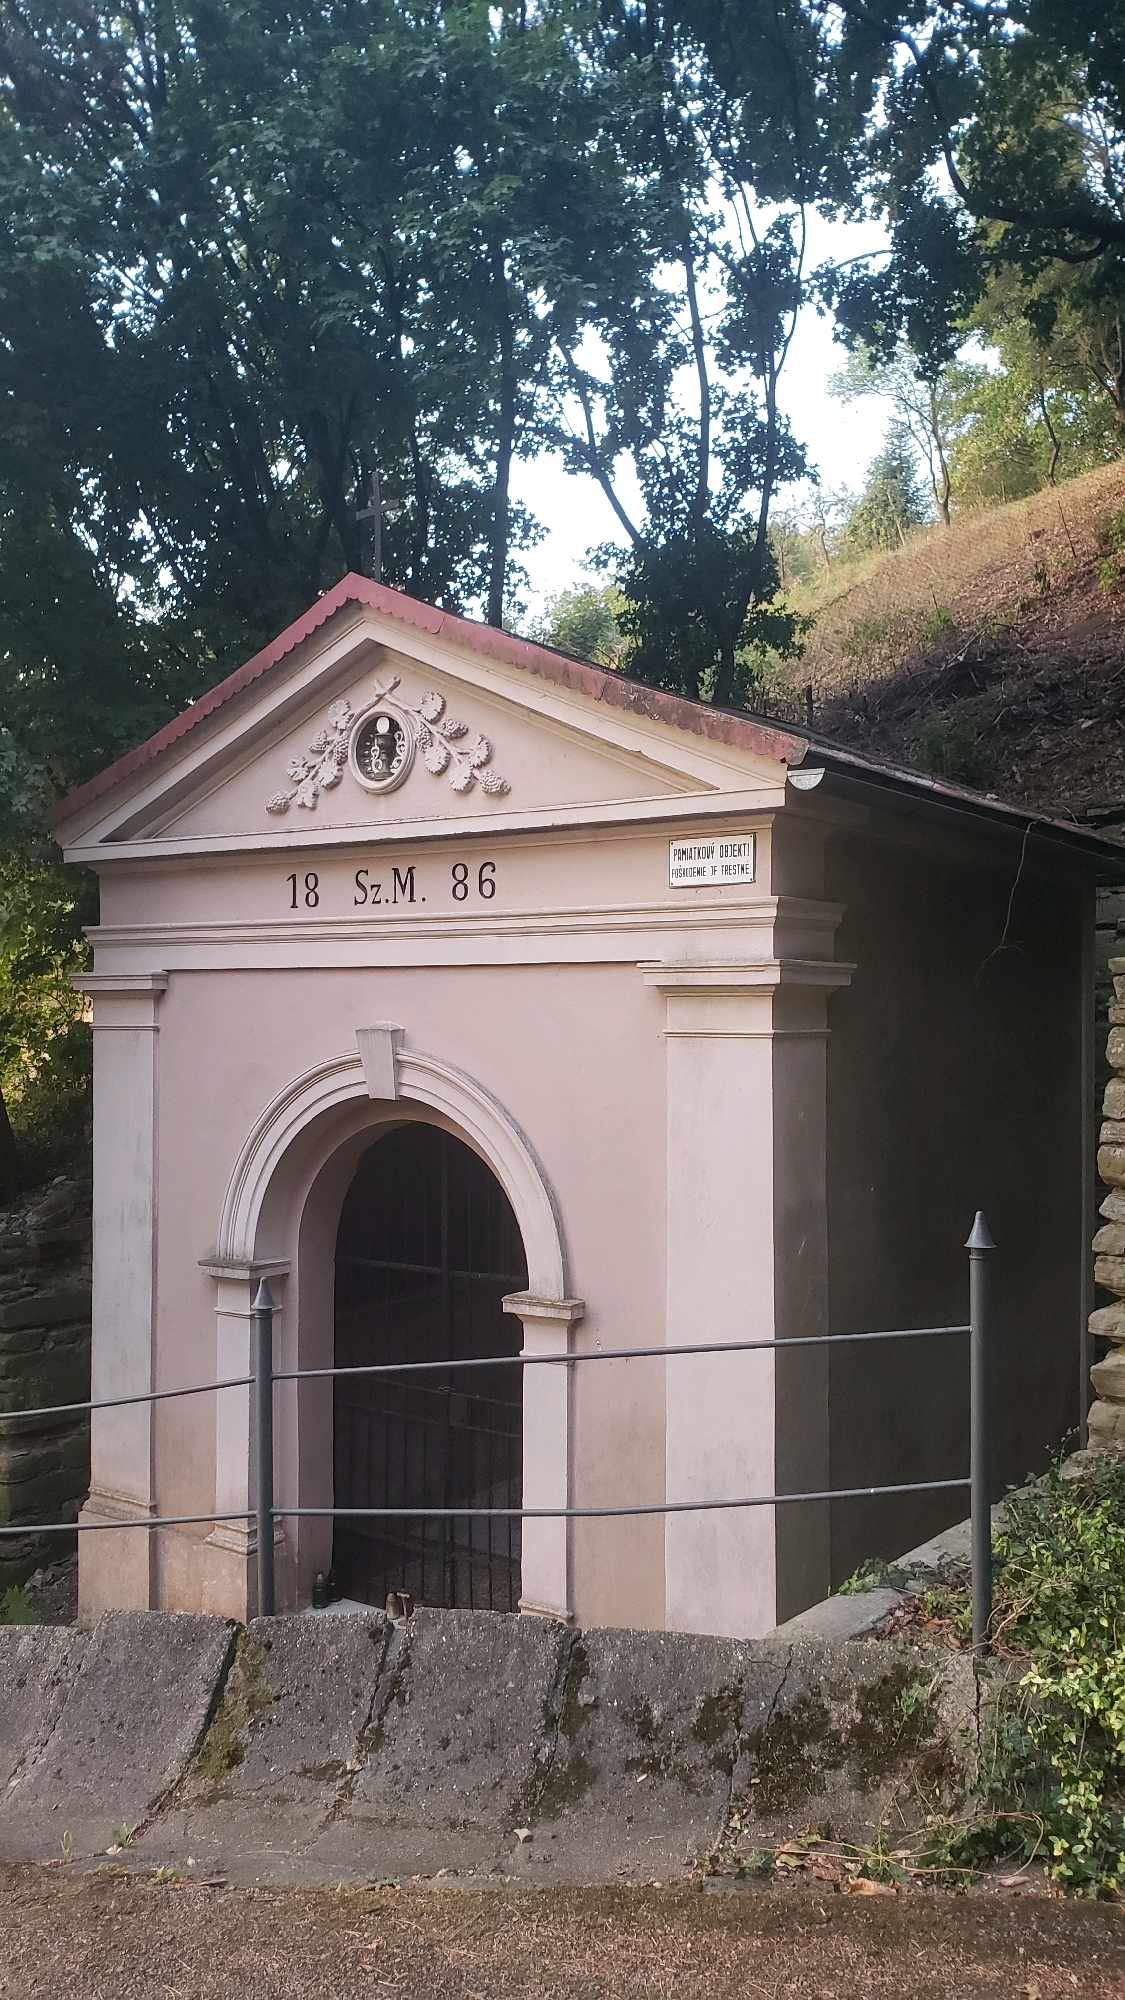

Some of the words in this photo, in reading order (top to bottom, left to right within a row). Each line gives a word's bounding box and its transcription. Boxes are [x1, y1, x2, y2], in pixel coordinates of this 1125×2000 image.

[673, 842, 715, 862] PAMIATKOVÝ
[719, 843, 750, 859] OBJEKT!
[286, 873, 319, 908] 18
[451, 861, 497, 901] 86
